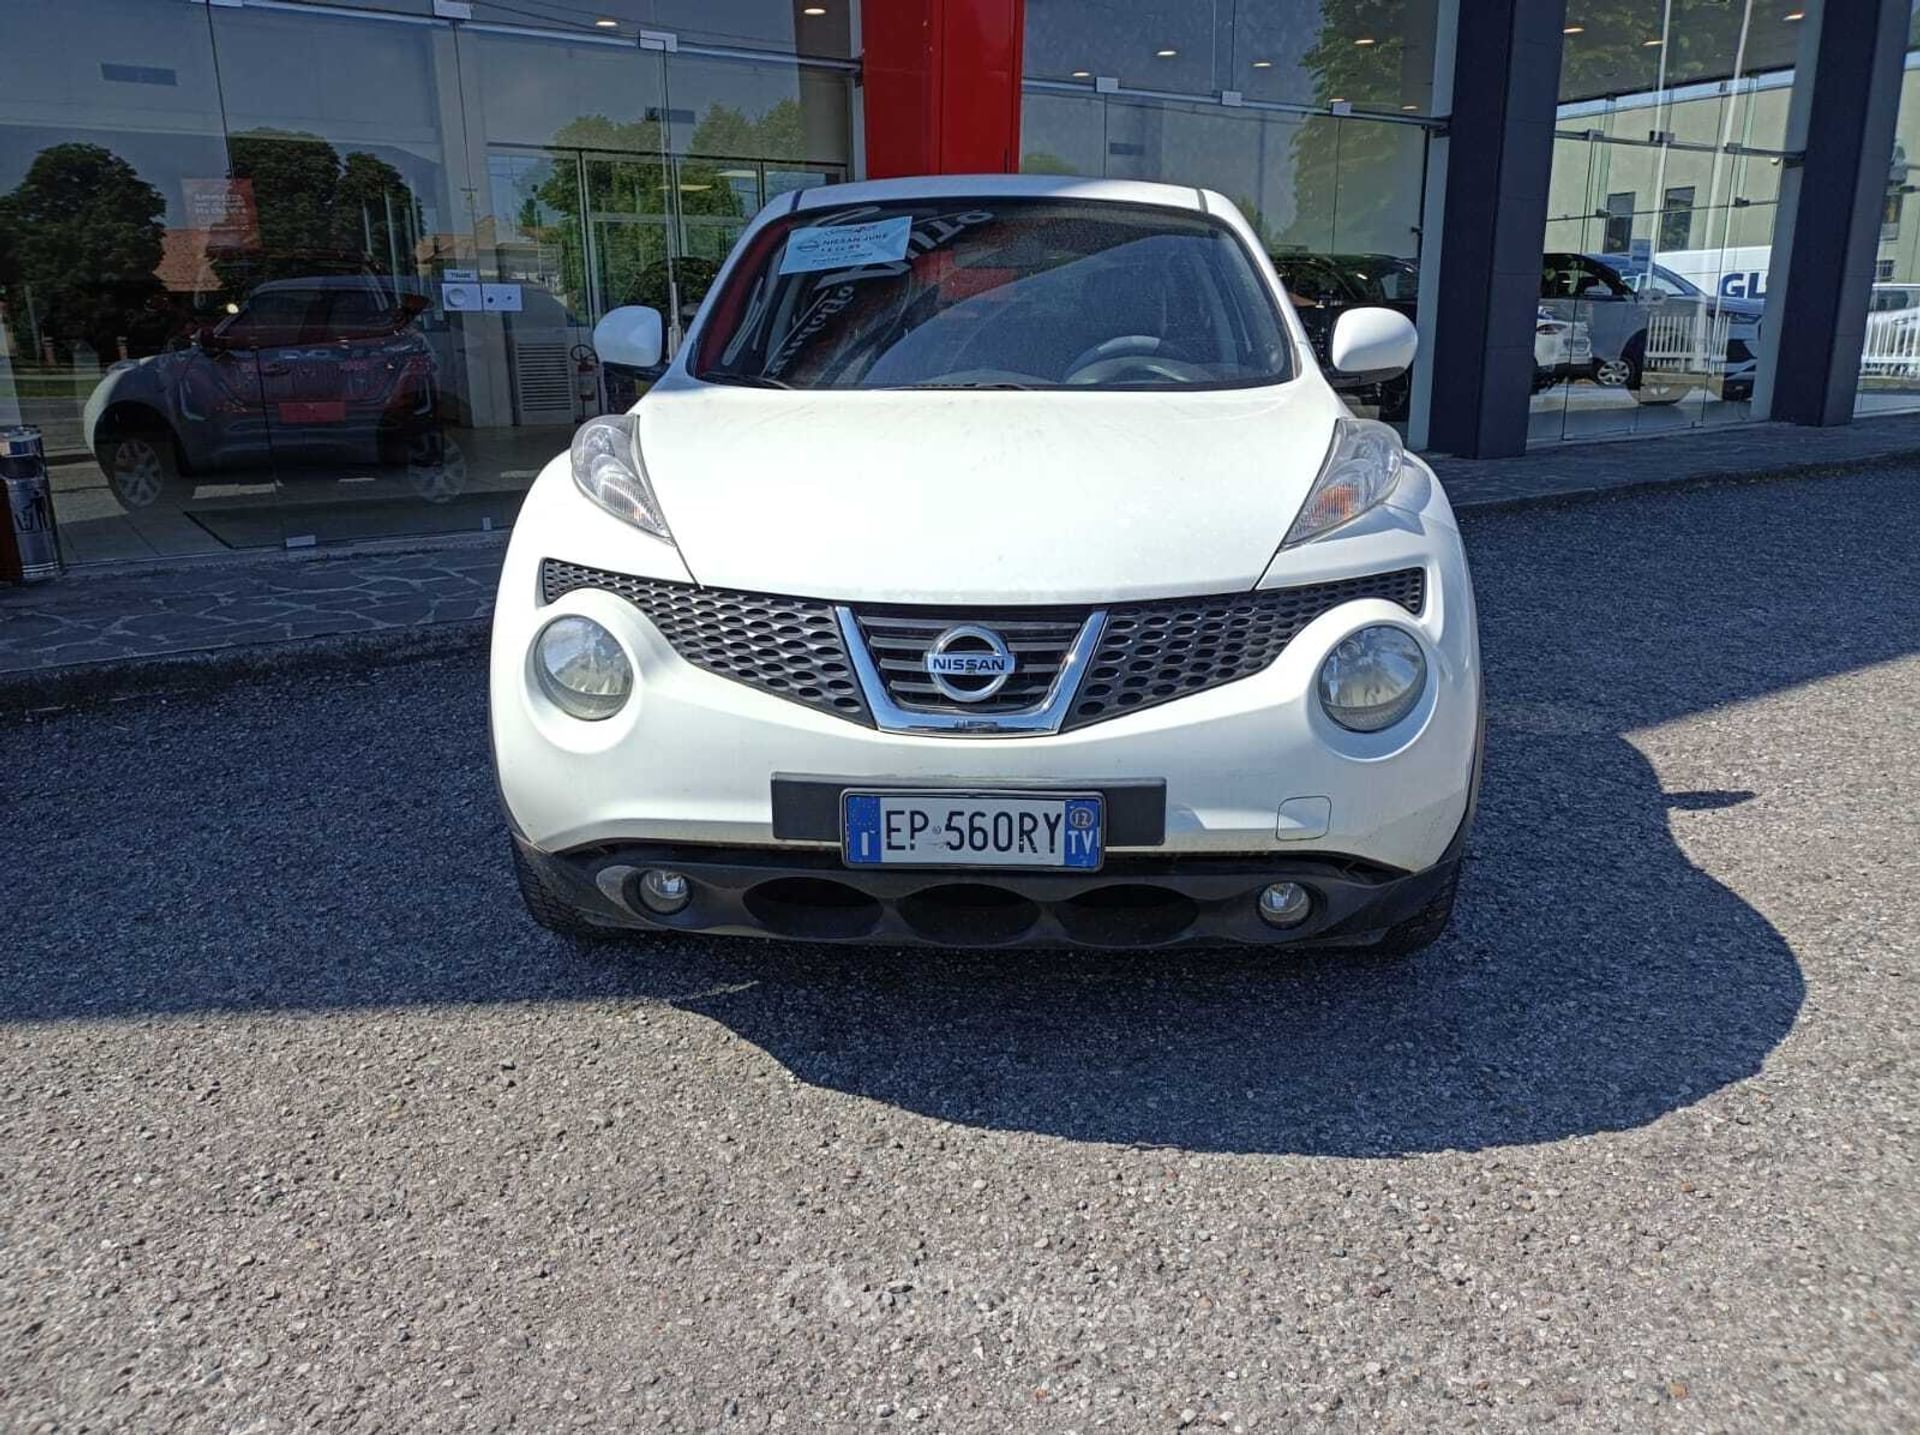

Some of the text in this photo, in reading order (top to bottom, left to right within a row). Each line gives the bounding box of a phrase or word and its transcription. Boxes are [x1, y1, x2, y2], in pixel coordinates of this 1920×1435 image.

[933, 658, 1005, 671] NISSAN
[886, 810, 930, 851] EP
[945, 811, 1062, 854] 560RY
[1067, 830, 1094, 855] TV
